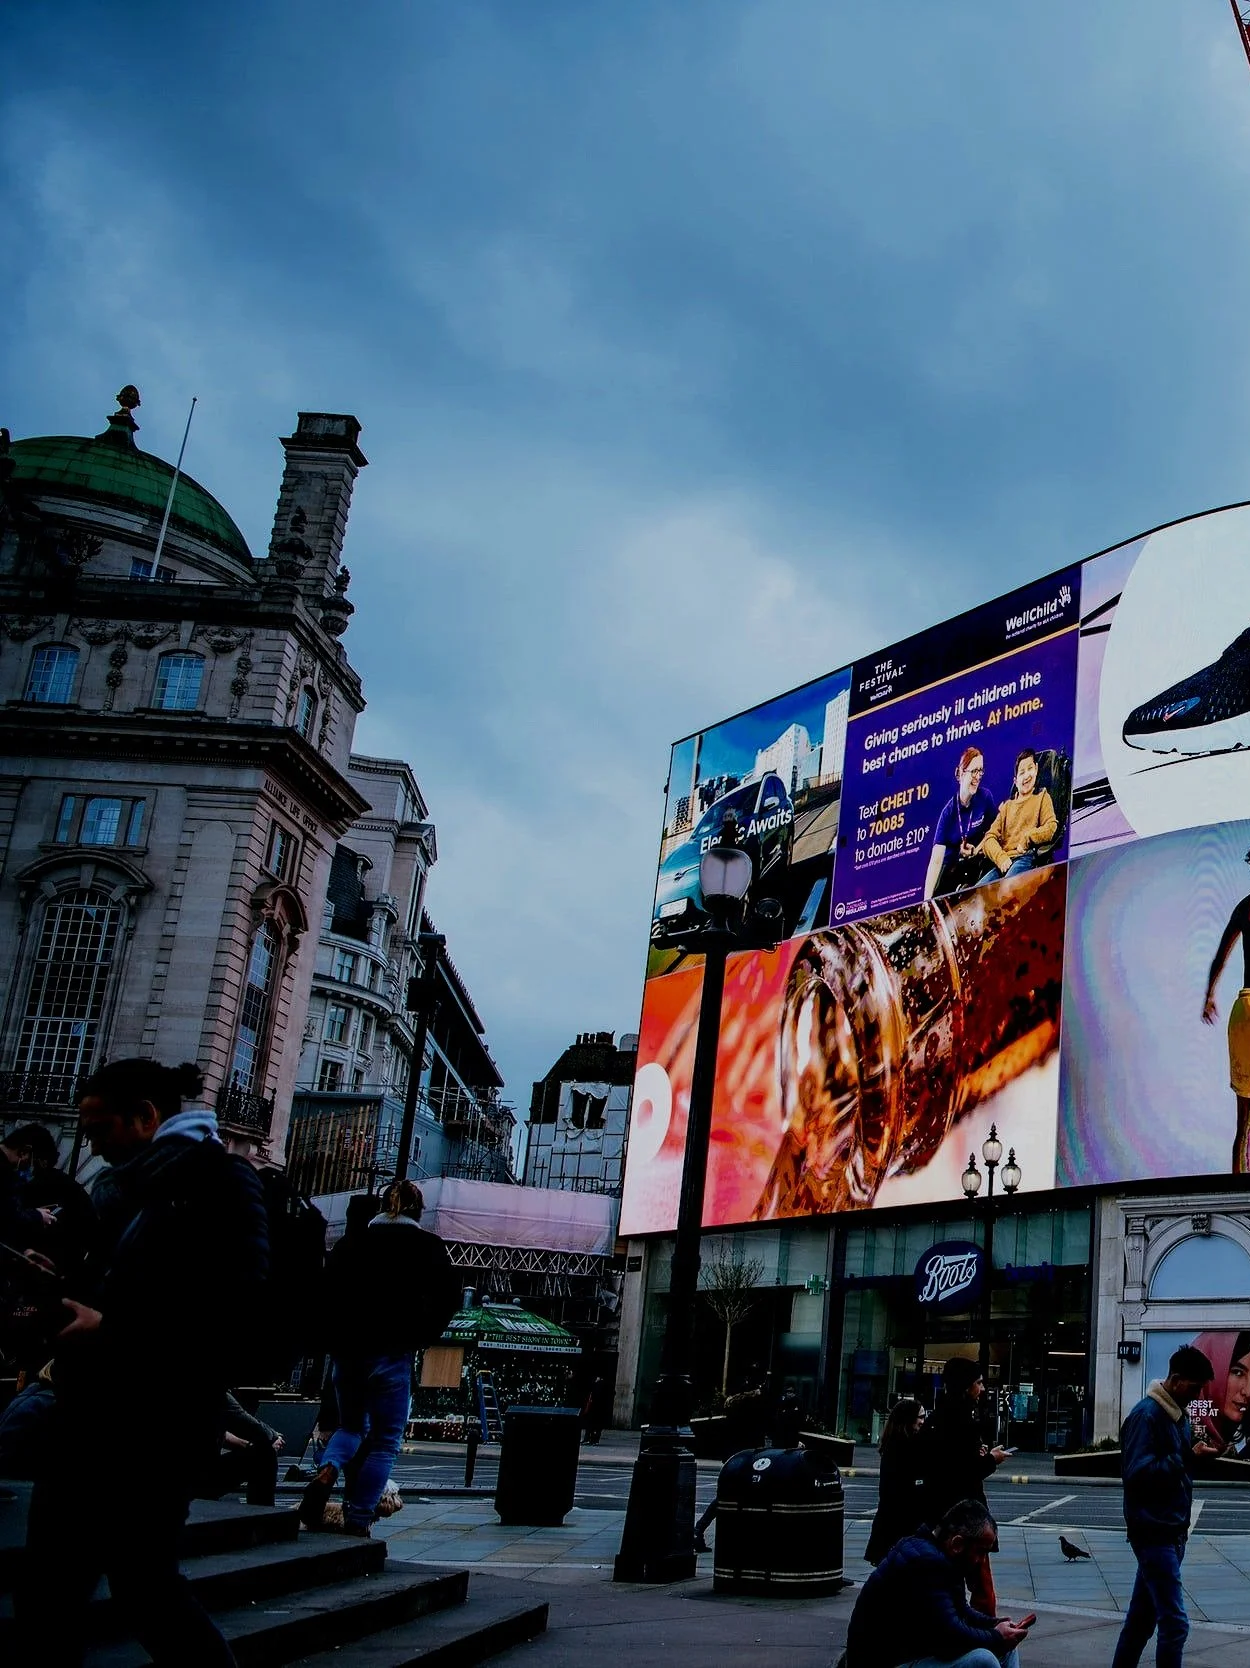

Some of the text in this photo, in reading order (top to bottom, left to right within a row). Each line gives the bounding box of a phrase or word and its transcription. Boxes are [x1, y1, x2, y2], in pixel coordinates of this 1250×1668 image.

[1005, 598, 1058, 632] WellChild
[874, 659, 893, 675] THE
[864, 671, 1042, 750] Giving seriously ill children the
[862, 695, 1044, 774] best chance to thrive. At home.
[859, 782, 930, 820] Text CHELT 10
[746, 807, 793, 839] Awaits
[856, 812, 905, 842] to 70085
[855, 848, 865, 863] to
[867, 836, 904, 859] donate
[917, 1252, 979, 1303] Boots
[1198, 1409, 1208, 1417] IS
[1208, 1409, 1220, 1417] AT
